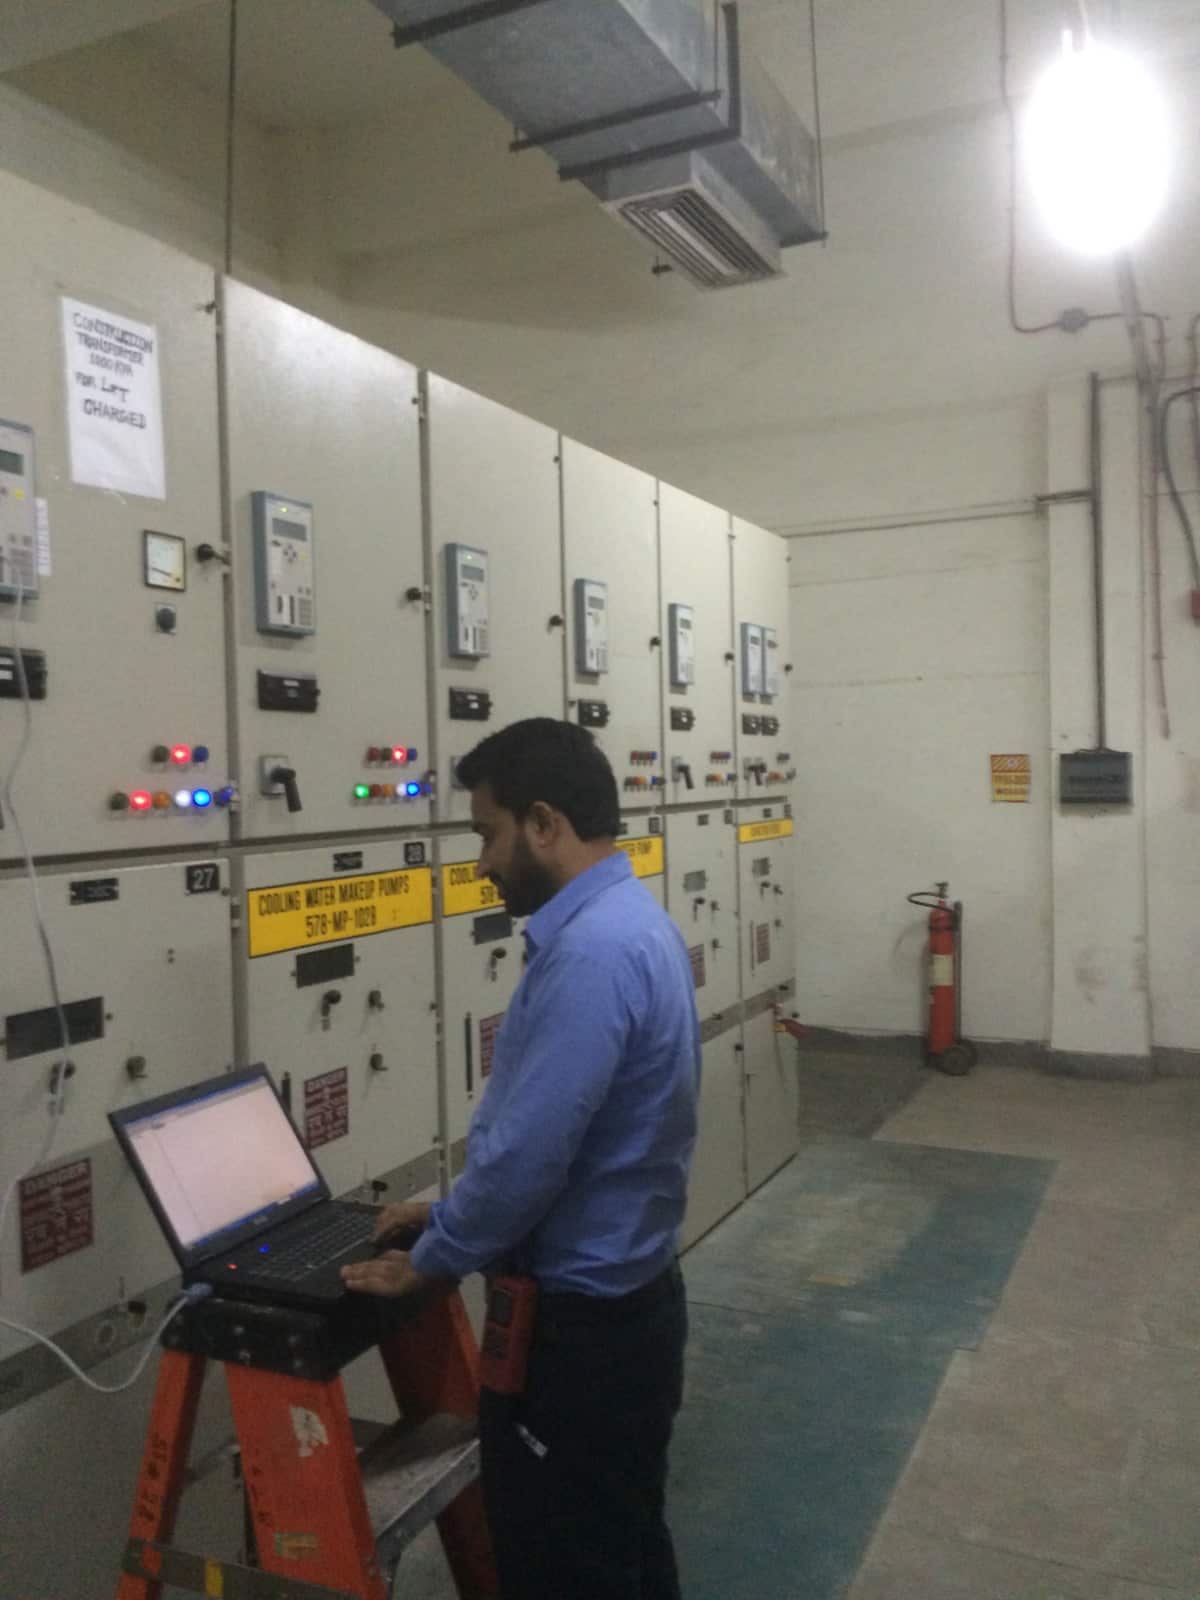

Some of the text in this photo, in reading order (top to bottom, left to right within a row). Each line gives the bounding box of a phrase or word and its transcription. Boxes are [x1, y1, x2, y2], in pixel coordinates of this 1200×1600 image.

[75, 331, 144, 366] TRANSFORMER
[83, 398, 147, 429] CHARGED
[192, 867, 214, 890] 27
[258, 874, 410, 917] COOLING WATER MAKEUP PUMPS
